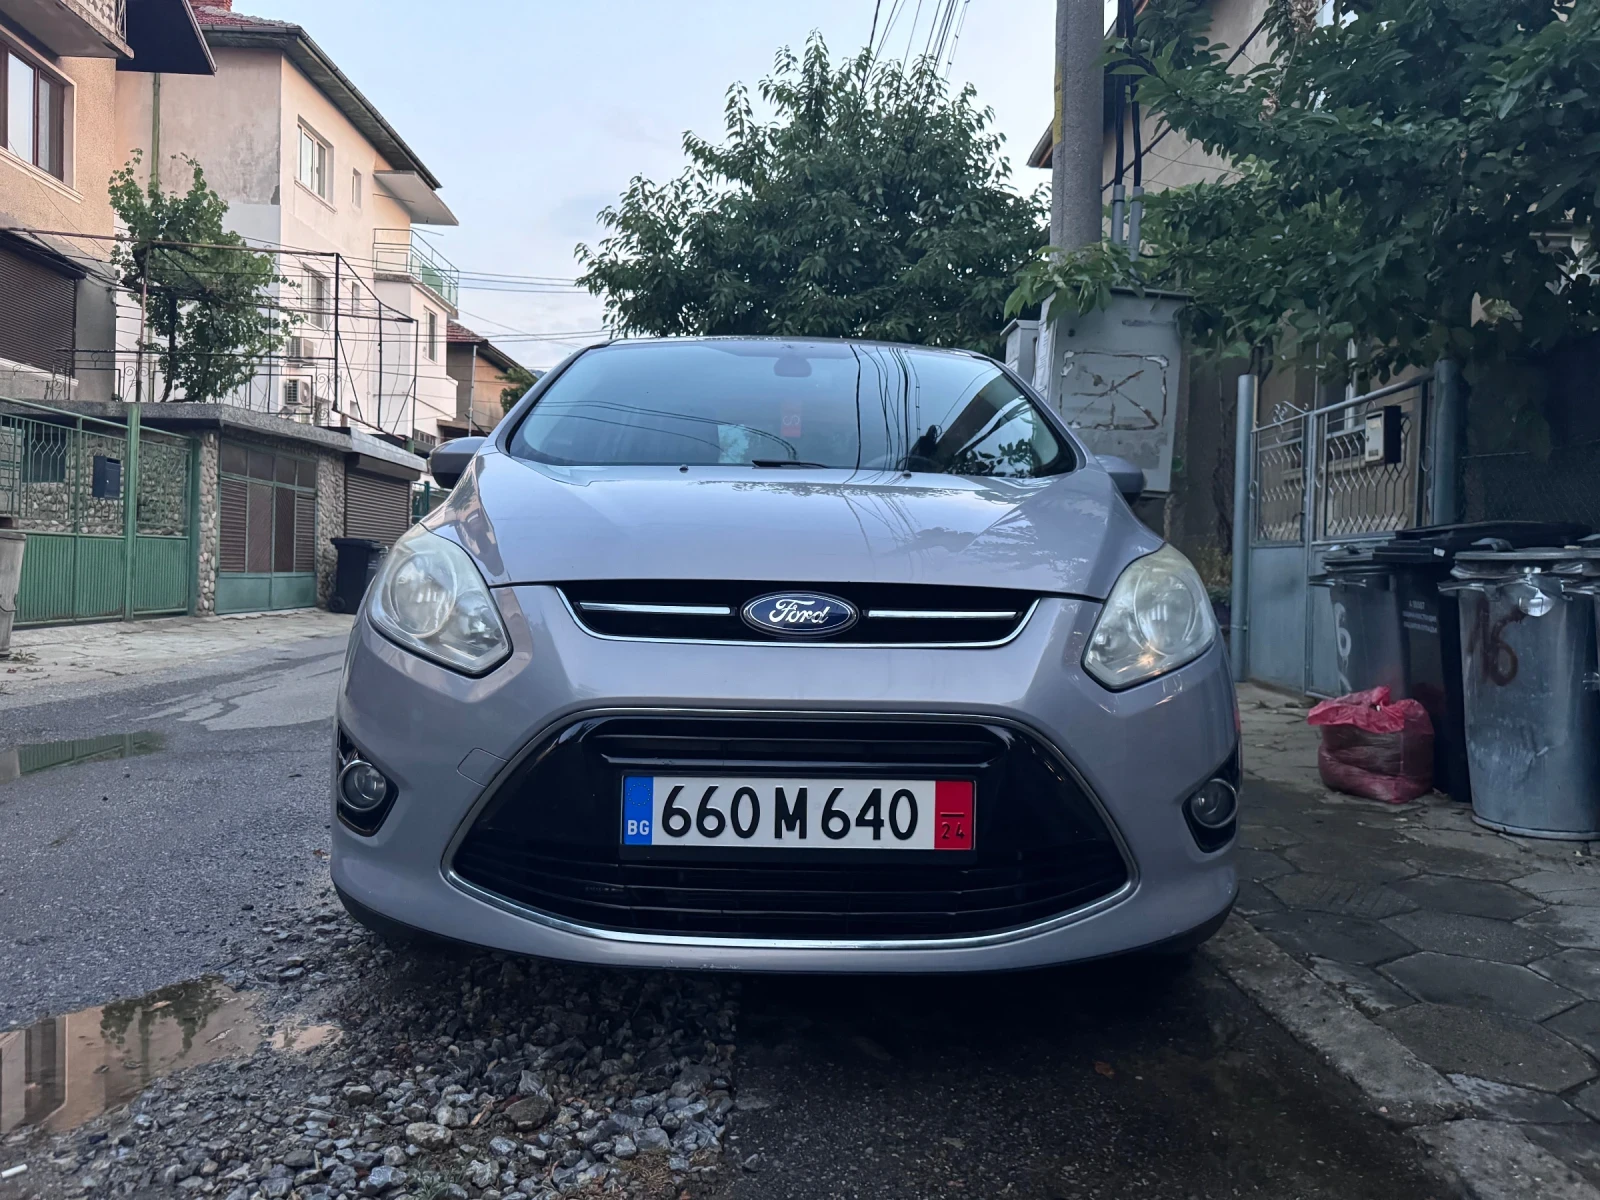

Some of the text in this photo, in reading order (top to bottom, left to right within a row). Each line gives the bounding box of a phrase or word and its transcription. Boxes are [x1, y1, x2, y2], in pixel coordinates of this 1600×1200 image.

[768, 598, 831, 624] Ford
[661, 784, 919, 841] 660 M 640
[627, 819, 650, 836] BG
[940, 821, 966, 840] 24
